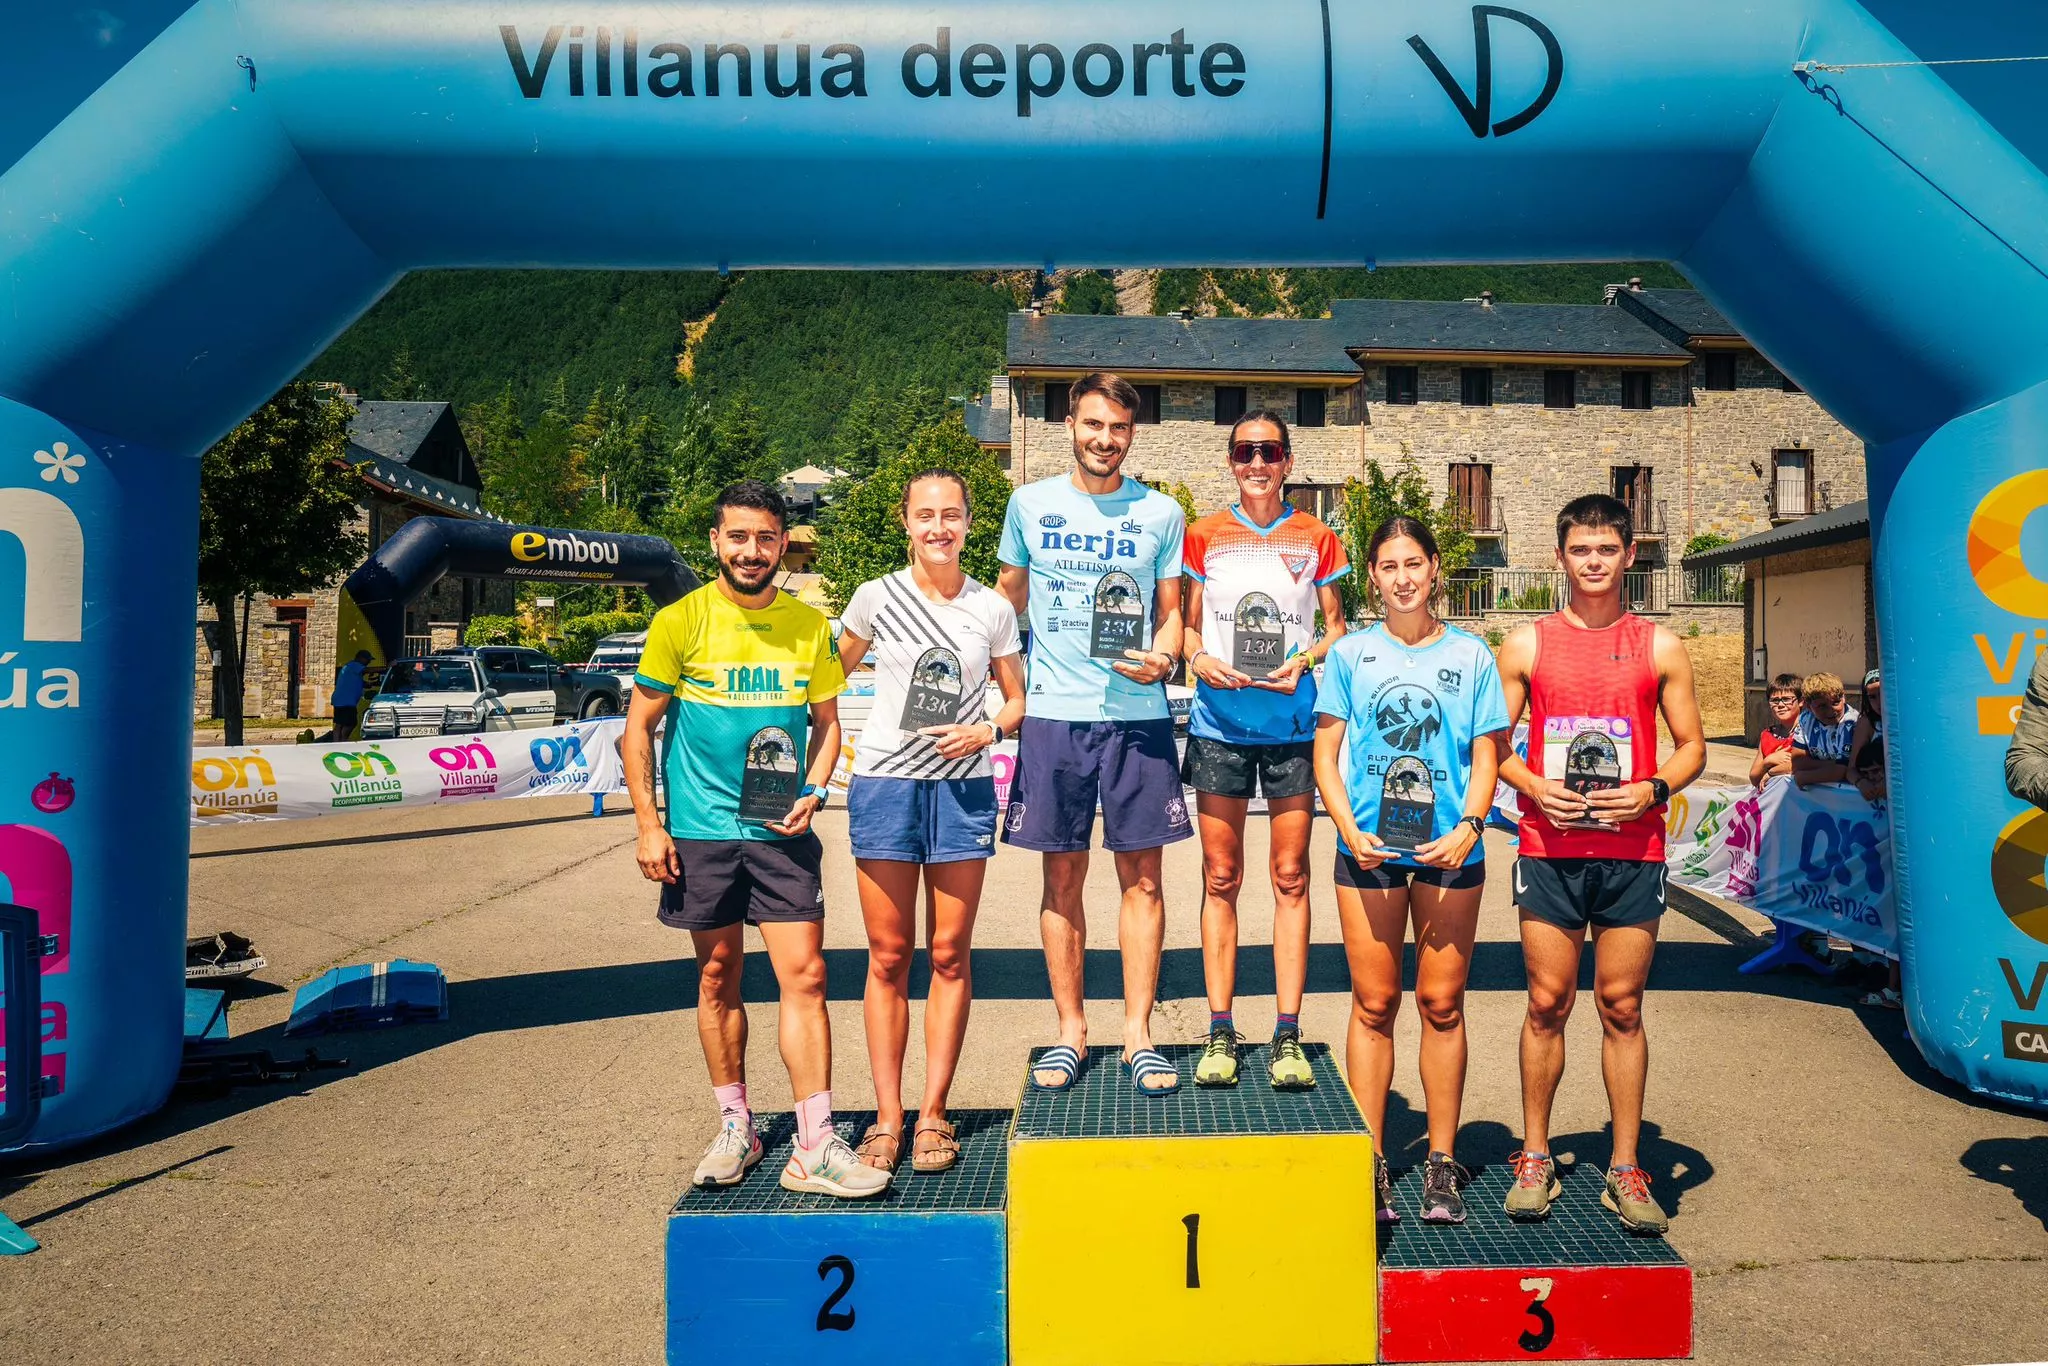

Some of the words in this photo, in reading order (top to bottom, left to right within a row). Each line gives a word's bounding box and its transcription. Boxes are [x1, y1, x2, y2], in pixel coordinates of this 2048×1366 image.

[500, 24, 868, 98] Villanúa
[901, 27, 1246, 117] deporte
[1041, 516, 1066, 527] TROPS
[510, 532, 619, 564] embou
[1040, 530, 1137, 560] nerja
[1054, 560, 1122, 573] ATLETISMO
[1241, 638, 1278, 656] 13K
[723, 665, 784, 692] TRAIL
[1371, 675, 1400, 699] SUBIDA
[728, 693, 749, 701] VALLE
[753, 693, 762, 701] DE
[766, 692, 782, 700] TENA
[914, 693, 952, 715] 13K
[331, 777, 402, 795] Villanúa
[440, 771, 498, 786] Villanúa
[192, 789, 278, 807] Villanúa
[1792, 881, 1883, 928] Villanúa
[1181, 1213, 1200, 1288] 1
[816, 1255, 855, 1332] 2
[1518, 1277, 1554, 1353] 3
